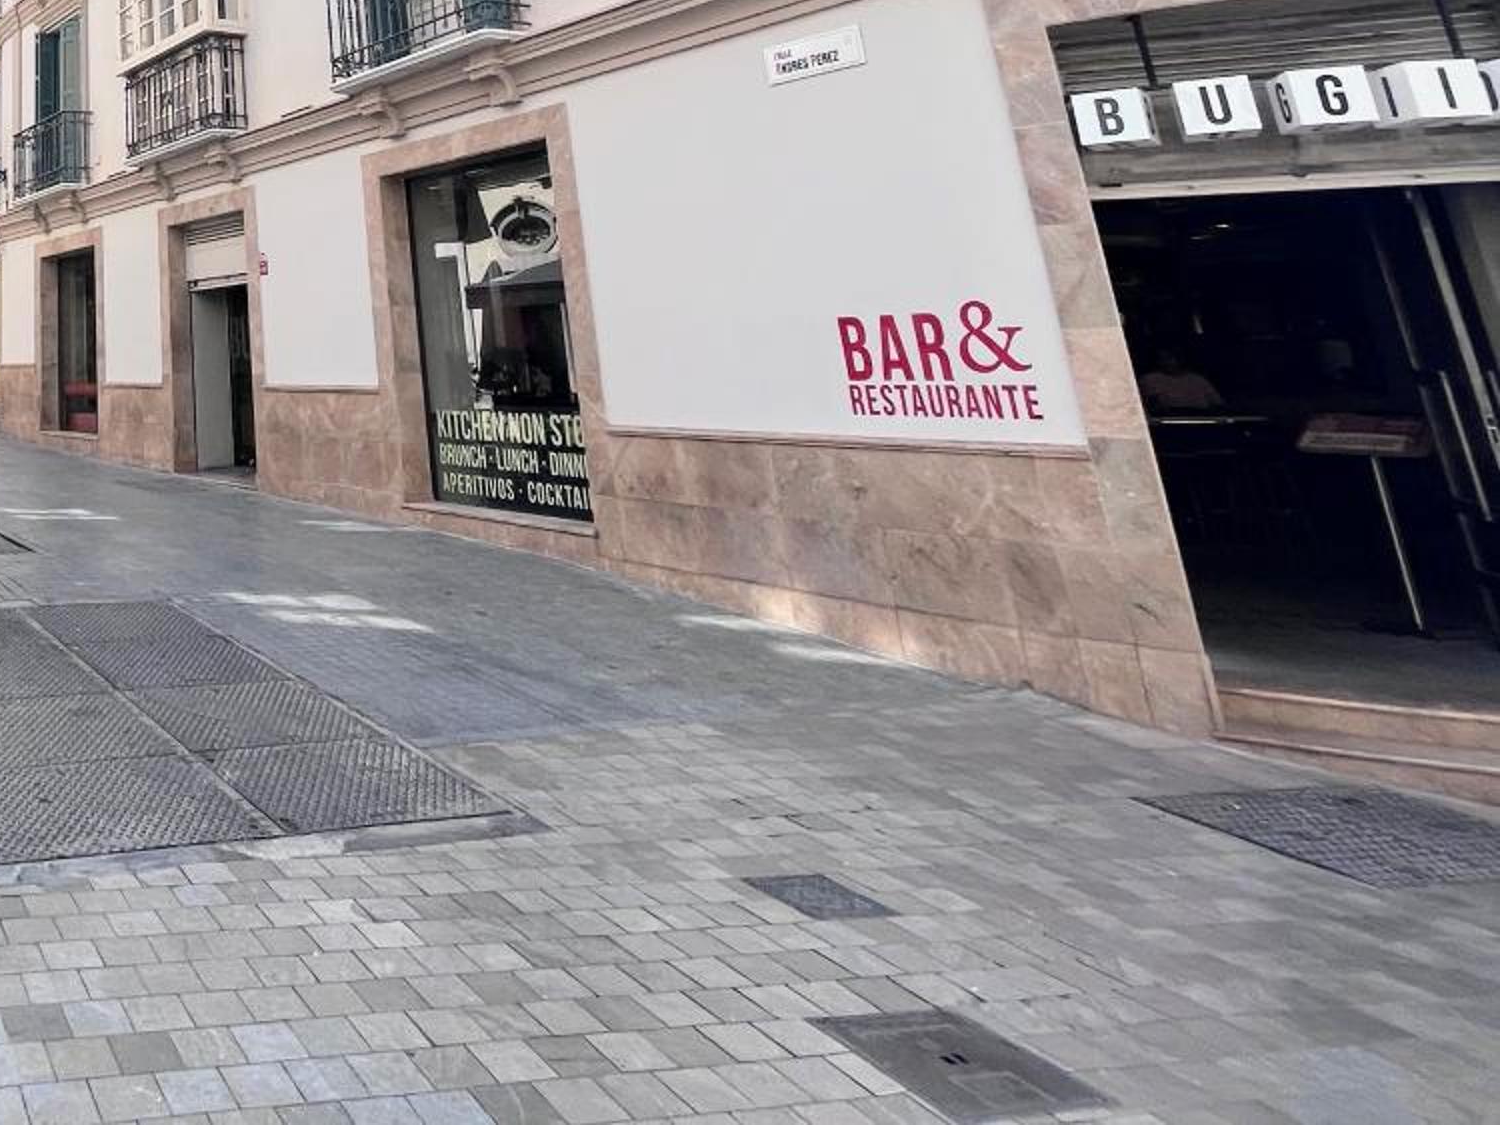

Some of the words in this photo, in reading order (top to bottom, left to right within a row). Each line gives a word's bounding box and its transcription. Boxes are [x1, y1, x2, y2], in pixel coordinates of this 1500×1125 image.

[850, 384, 1044, 420] RESTAURANTE
[436, 410, 504, 441] KITCHEN
[507, 412, 546, 445] NON
[440, 443, 486, 469] BRUNCH
[496, 446, 539, 474] LUNCH
[550, 452, 588, 478] DINN
[443, 472, 514, 500] APERITIVOS
